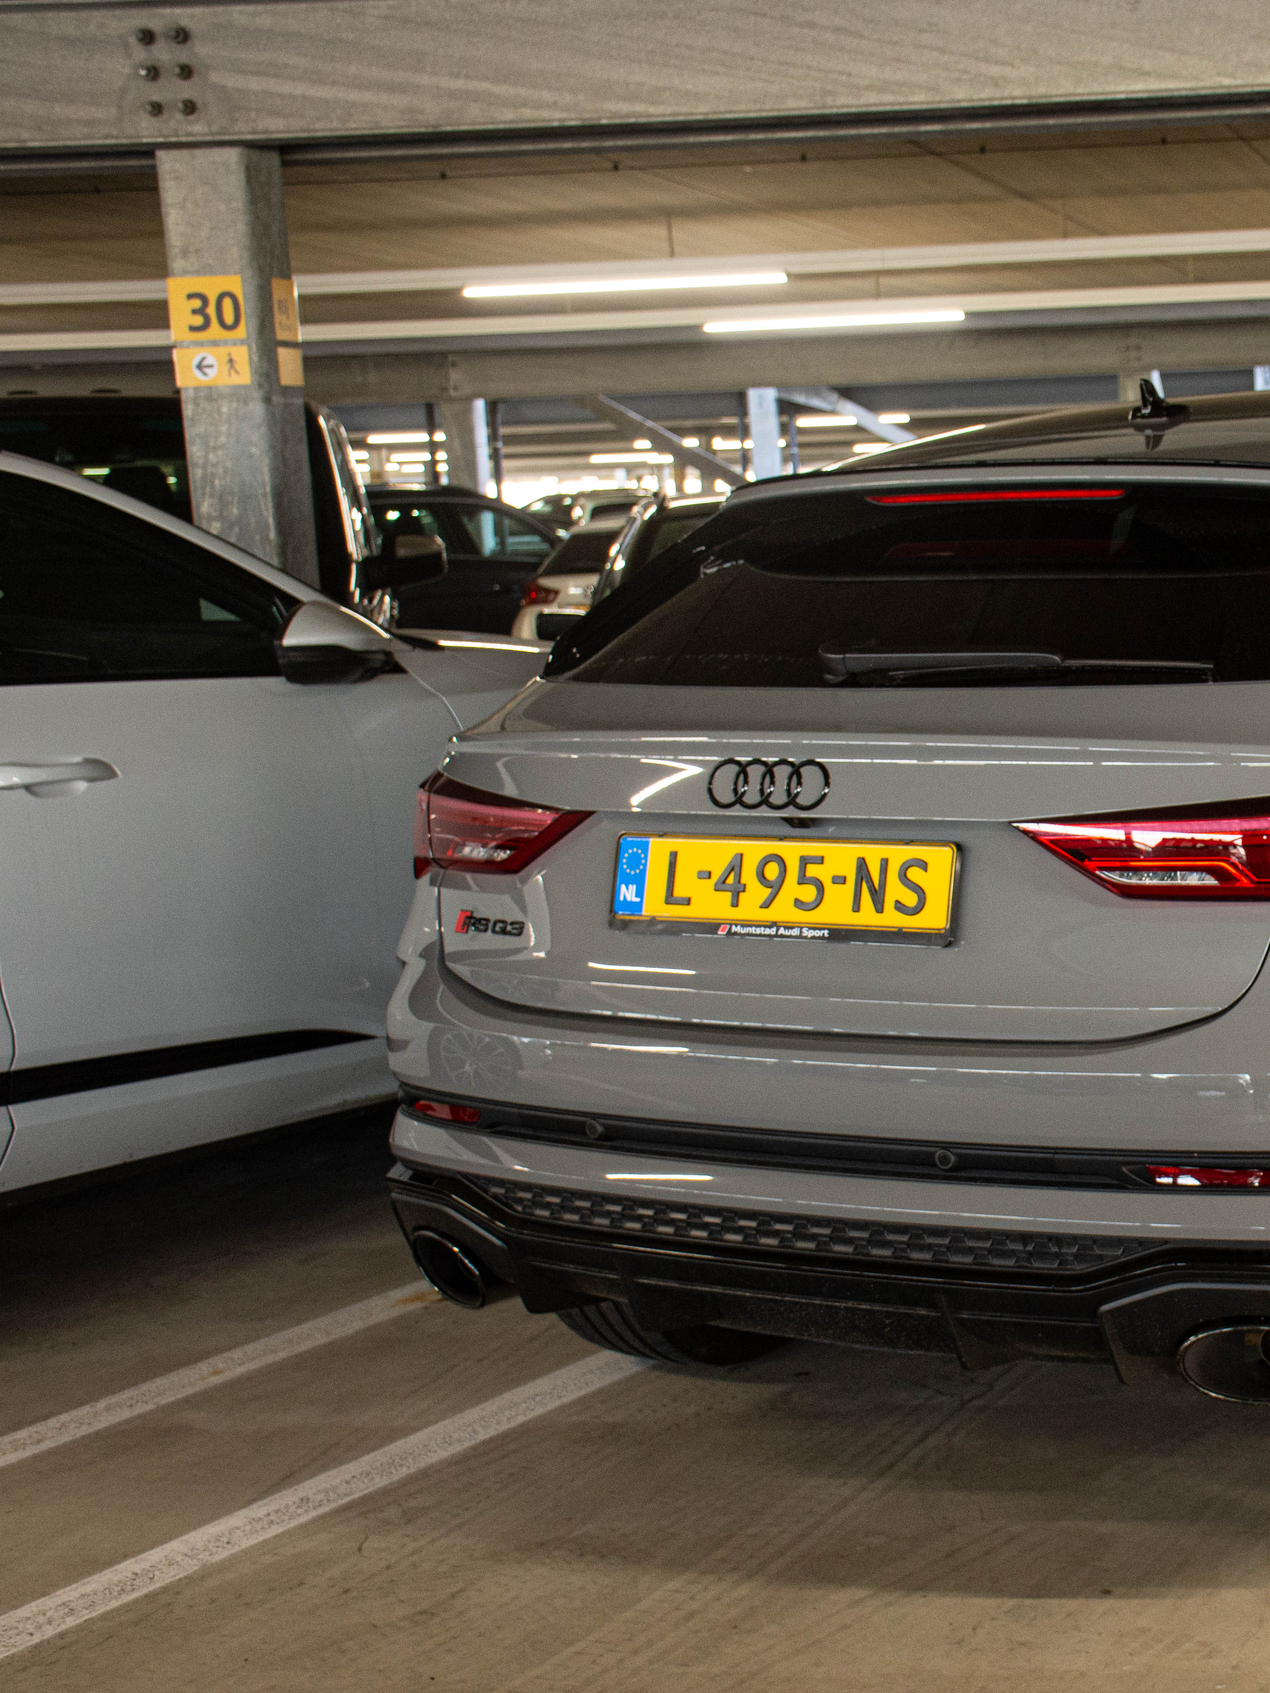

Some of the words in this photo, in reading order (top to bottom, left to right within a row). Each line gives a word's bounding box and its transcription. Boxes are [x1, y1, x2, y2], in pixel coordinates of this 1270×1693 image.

[185, 291, 243, 332] 30
[619, 884, 641, 902] NL
[664, 850, 928, 916] L-495-NS
[731, 924, 777, 935] Muntstad
[778, 926, 800, 936] Audi
[801, 927, 830, 938] Sport
